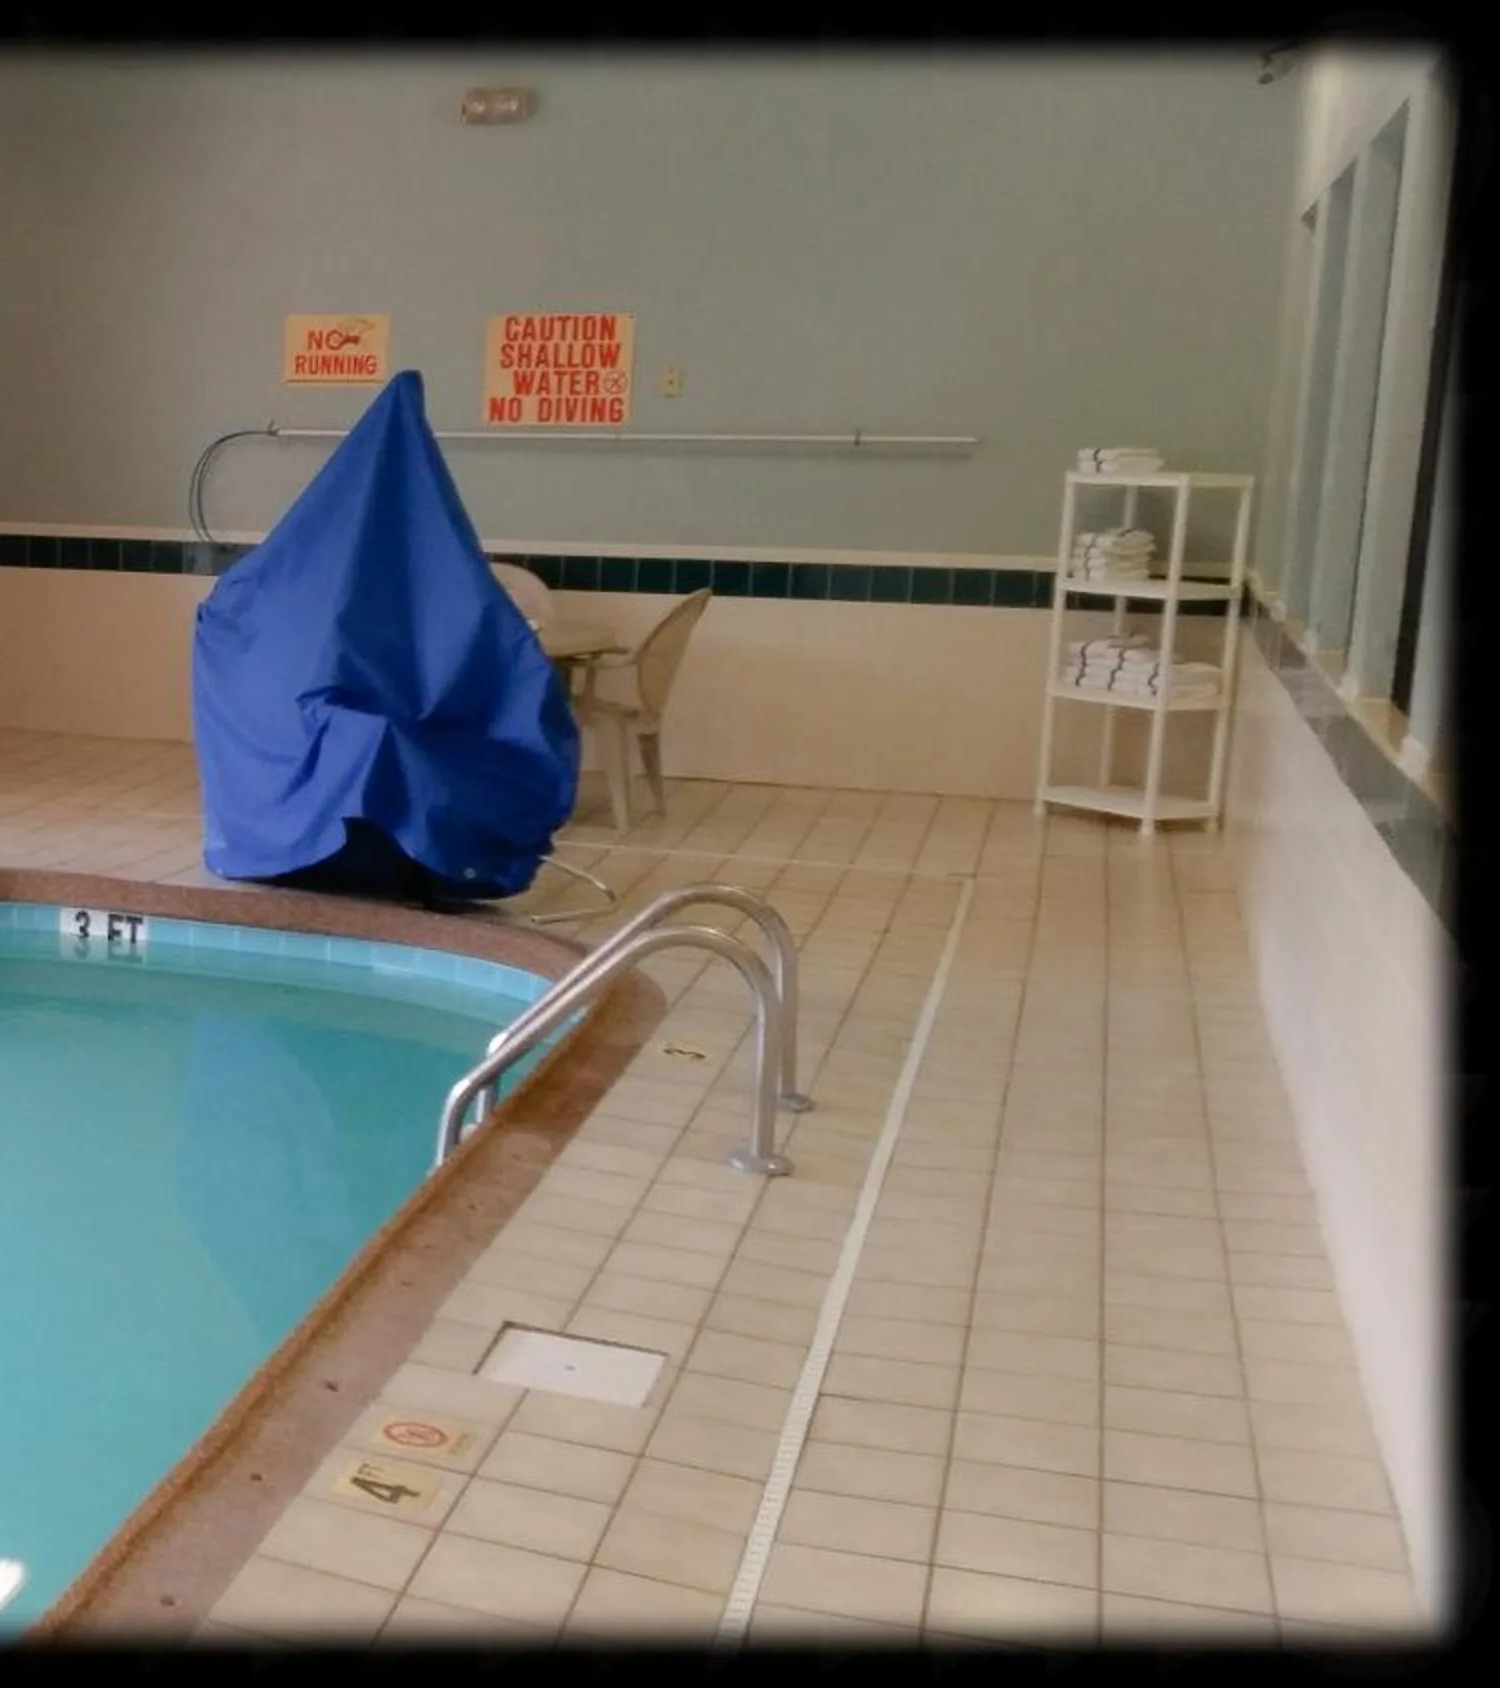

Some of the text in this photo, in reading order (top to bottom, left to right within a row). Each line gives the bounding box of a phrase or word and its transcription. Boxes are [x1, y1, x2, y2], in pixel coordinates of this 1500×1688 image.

[308, 329, 343, 351] NO
[505, 316, 616, 341] CAUTION
[295, 355, 377, 375] RUNNING
[500, 343, 620, 368] SHALLOW
[514, 370, 599, 395] WATER
[490, 397, 624, 423] NO DIVING
[75, 910, 143, 943] 3 FT
[351, 1476, 421, 1505] 4
